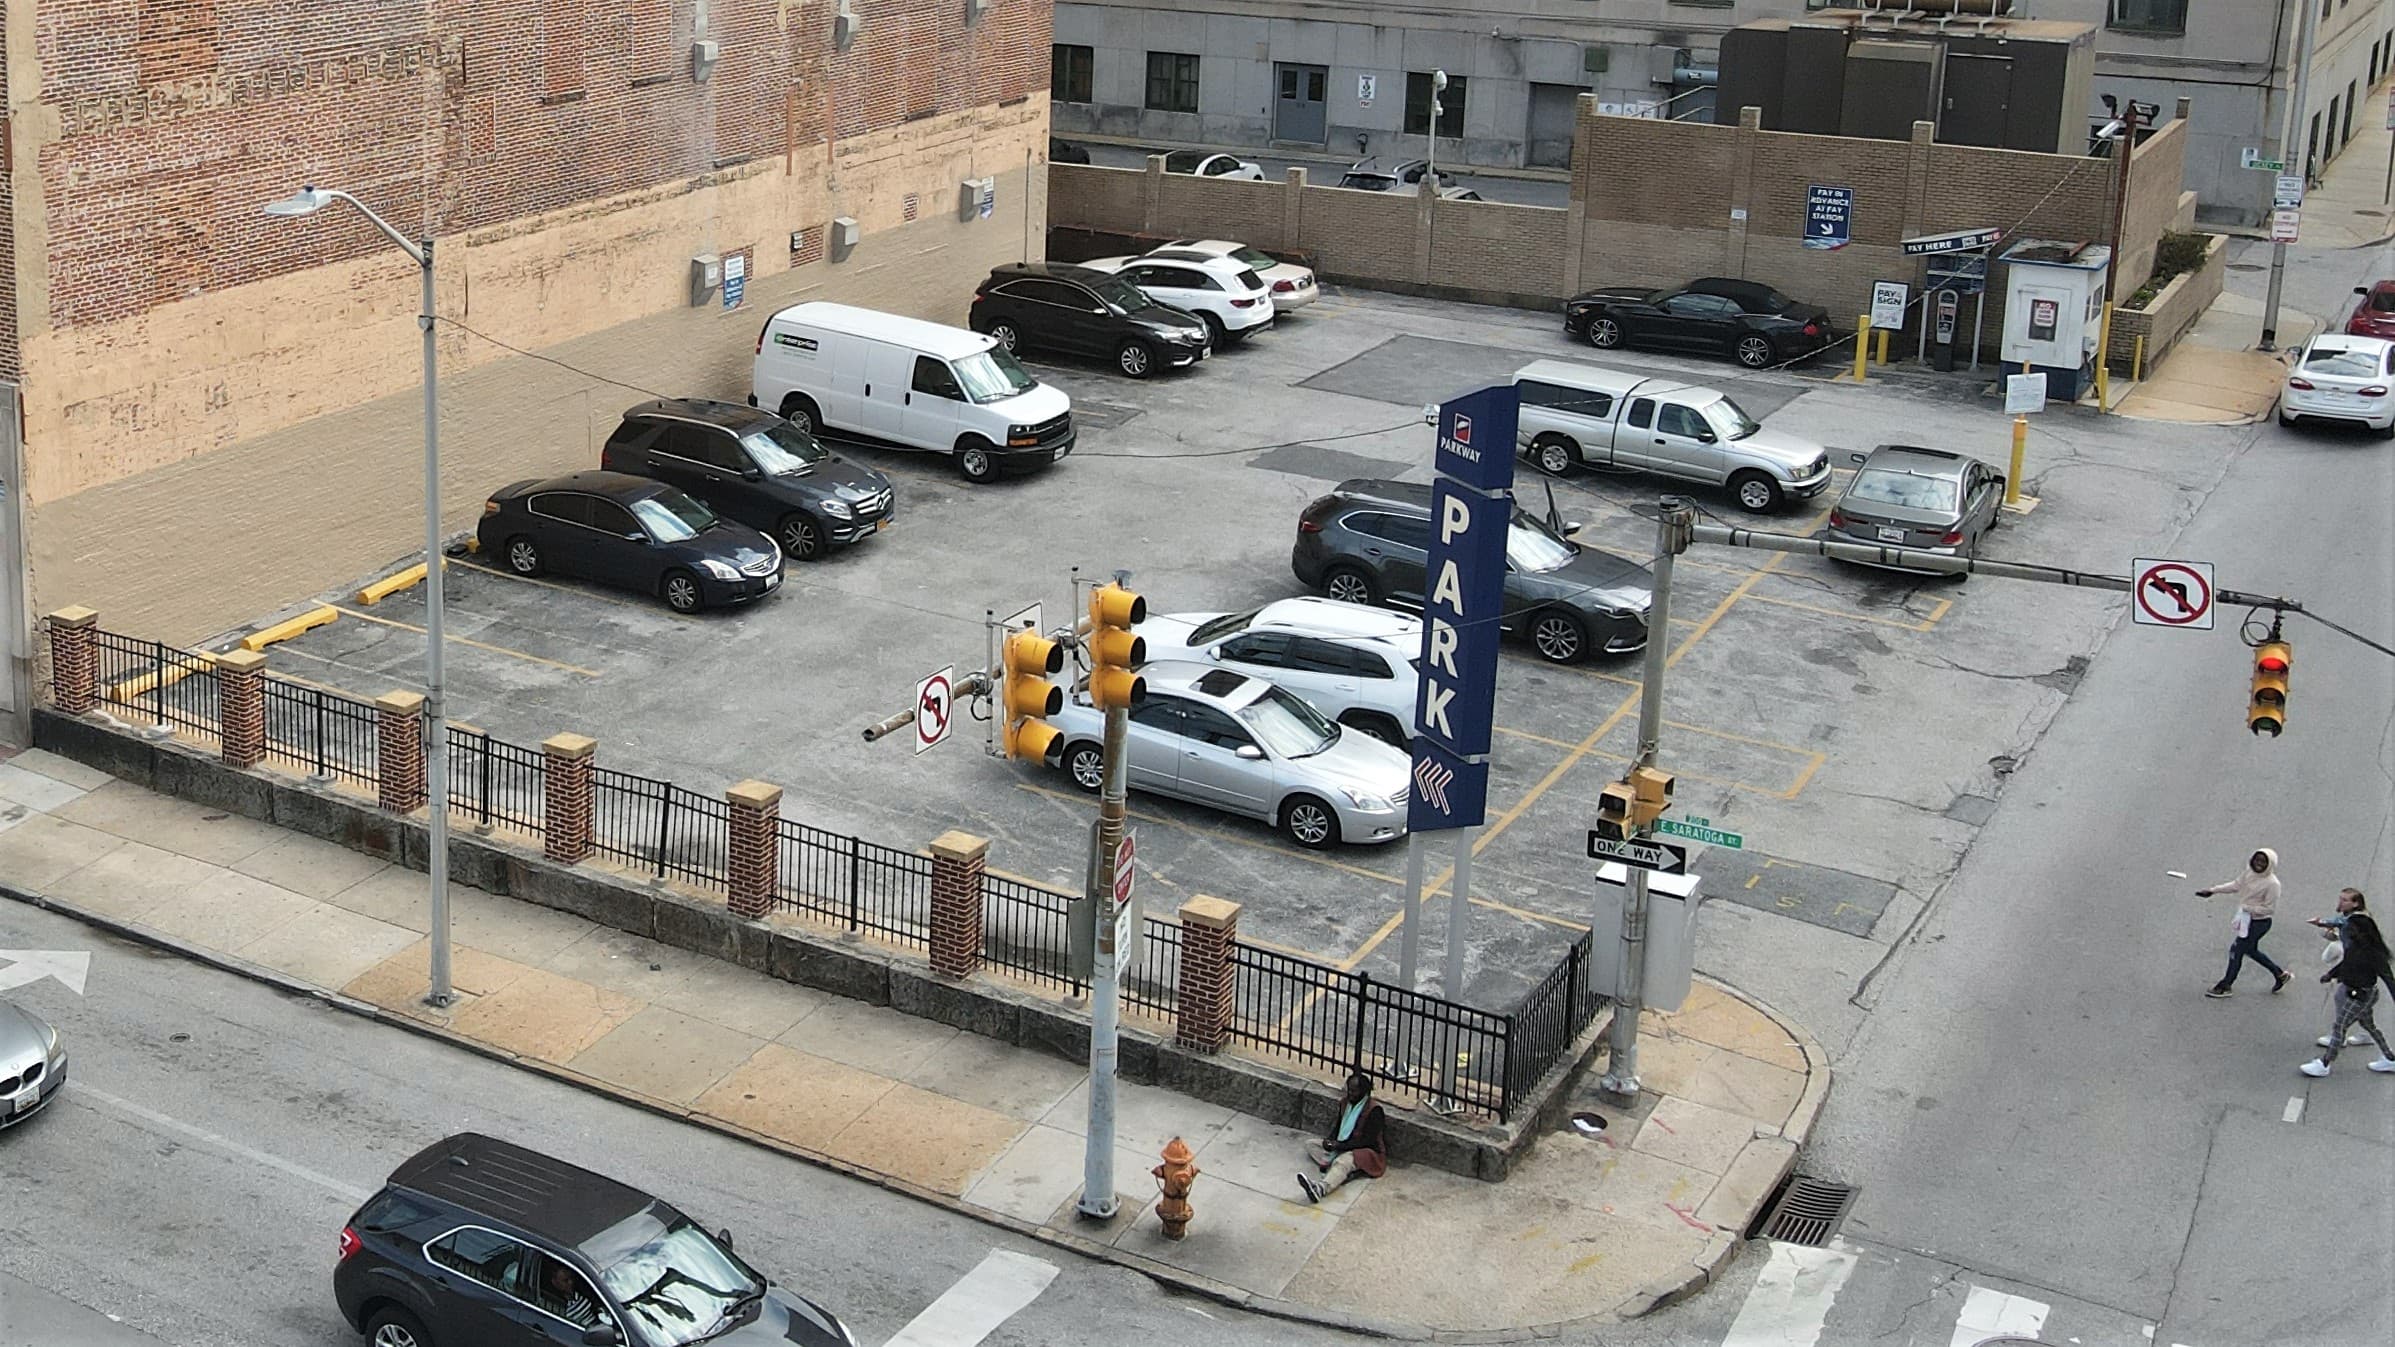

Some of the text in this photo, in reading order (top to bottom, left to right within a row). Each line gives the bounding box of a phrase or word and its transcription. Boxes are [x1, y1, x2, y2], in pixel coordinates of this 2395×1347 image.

[1908, 244, 1923, 252] PAY
[1925, 240, 1953, 251] HERE
[1877, 289, 1897, 297] PAY
[1877, 297, 1902, 305] SIGN
[1440, 436, 1481, 464] PARKWAY
[1424, 494, 1471, 740] PARK
[1672, 822, 1725, 845] SARATOGA
[1633, 847, 1663, 862] WAY
